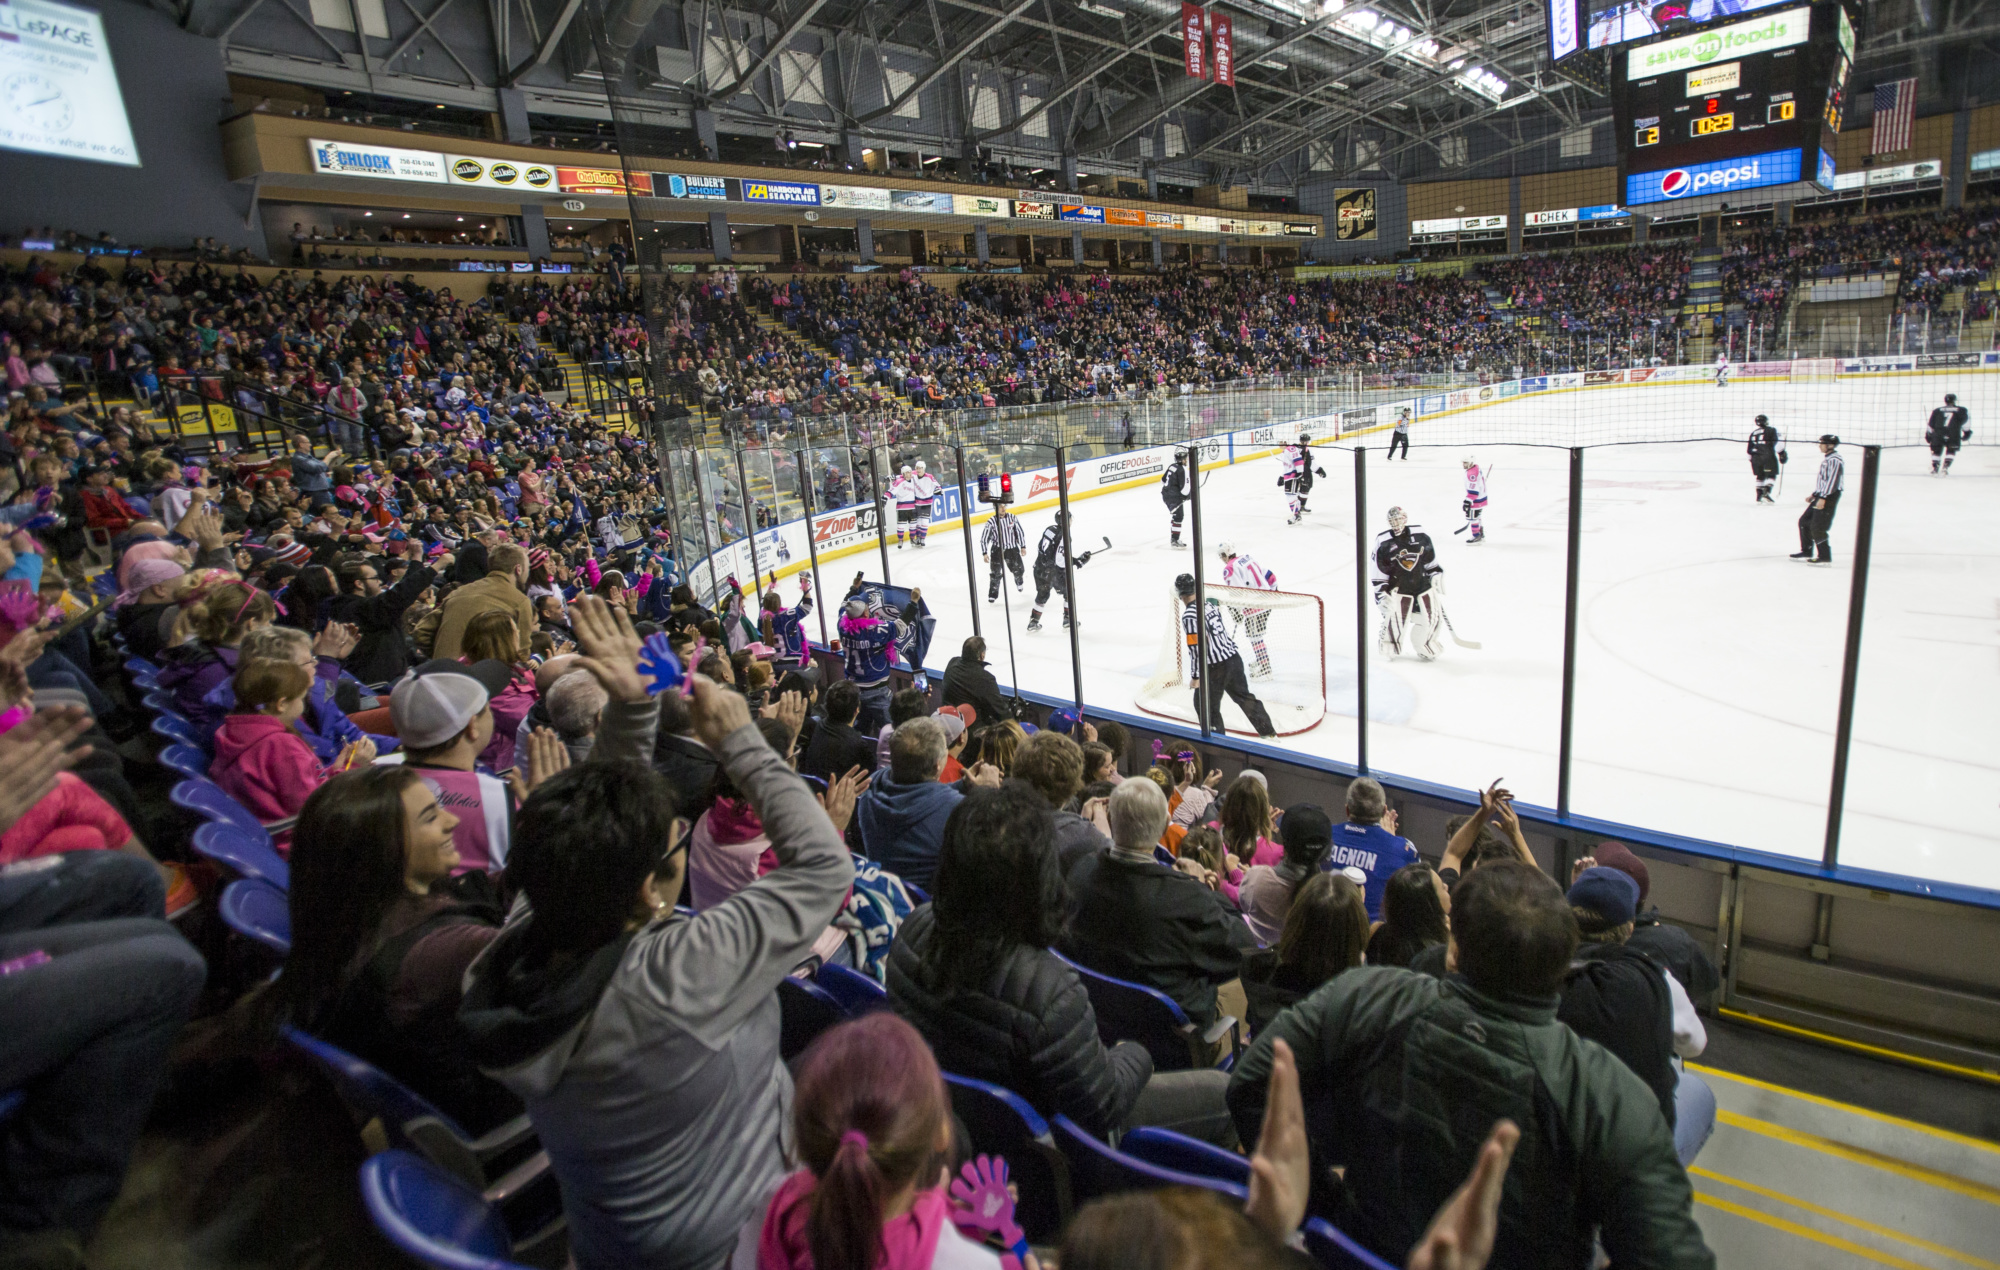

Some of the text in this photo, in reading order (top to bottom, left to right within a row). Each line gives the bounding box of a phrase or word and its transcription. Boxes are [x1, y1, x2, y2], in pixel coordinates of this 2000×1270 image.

[1646, 21, 1788, 67] save on foods
[1770, 92, 1794, 102] VISITOR
[1707, 99, 1718, 114] 2
[1780, 101, 1794, 120] 0
[1697, 114, 1733, 135] 10:23
[1647, 127, 1659, 144] 2
[577, 170, 618, 185] Old Dutch
[686, 176, 726, 188] BUILDER'S
[1694, 161, 1761, 192] pepsi
[688, 186, 726, 196] CHOICE
[768, 185, 803, 195] HARBOUR
[803, 187, 816, 196] AIR
[769, 193, 817, 203] SEAPLANES
[566, 201, 582, 210] 115
[1017, 203, 1040, 213] Zone
[1083, 206, 1102, 217] Budget
[1358, 269, 1372, 278] FUN
[814, 515, 856, 543] Zone
[1345, 825, 1367, 834] Reebok
[1330, 845, 1378, 872] AGNON
